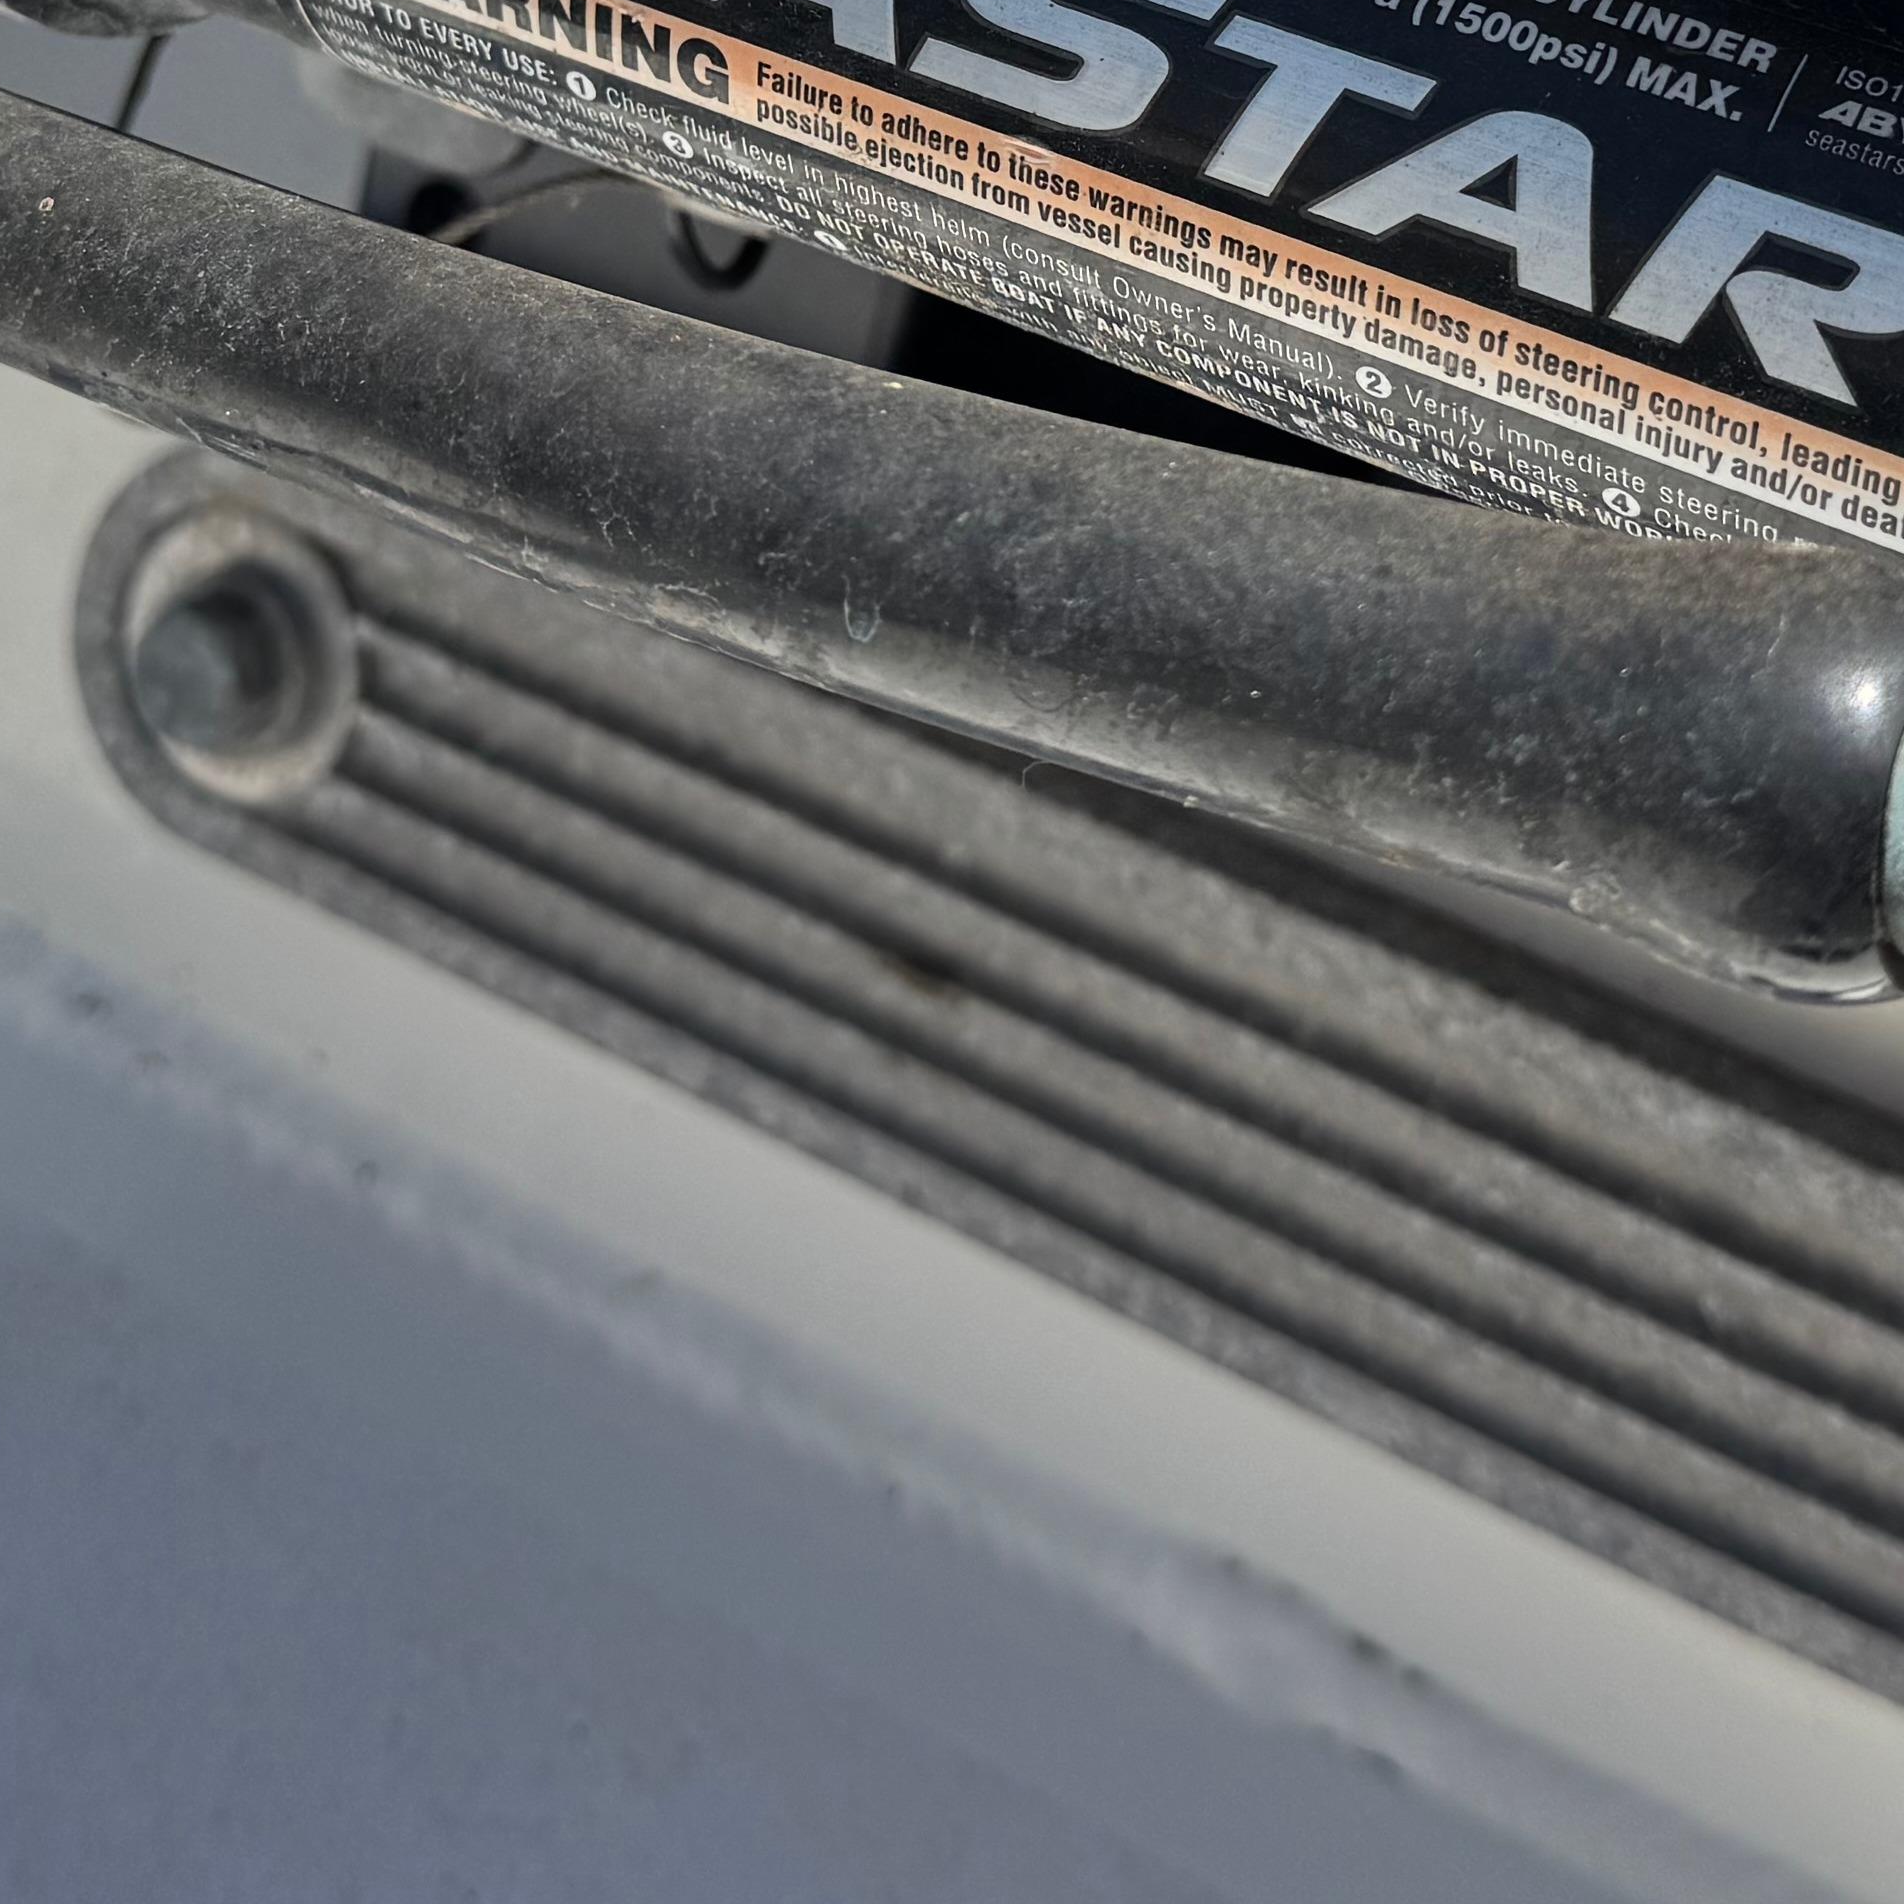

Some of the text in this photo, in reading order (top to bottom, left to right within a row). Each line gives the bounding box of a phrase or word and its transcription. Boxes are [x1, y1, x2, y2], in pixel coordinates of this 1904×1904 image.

[379, 1, 412, 31] TO
[420, 16, 493, 61] EVERY
[502, 48, 558, 86] USE:
[606, 87, 676, 127] Check
[682, 115, 732, 150] fluid
[742, 136, 793, 173] level
[804, 162, 824, 185] in
[835, 173, 921, 222] highest
[932, 204, 989, 247] helm
[1003, 236, 1100, 289] (consult
[1113, 276, 1216, 331] Owner's
[1229, 318, 1342, 380] Manual).
[1405, 384, 1485, 435] Verify
[1498, 420, 1645, 493] immediate
[1659, 485, 1778, 543] steering
[1626, 56, 1743, 122] MAX.
[704, 148, 788, 194] Inspect
[796, 186, 823, 207] all
[833, 199, 928, 250] steering
[937, 236, 1009, 277] hoses
[1019, 269, 1062, 298] and
[1073, 287, 1161, 336] fittings
[1173, 325, 1206, 352] for
[1299, 372, 1395, 427] kinking
[1407, 417, 1496, 460] and/or
[1508, 452, 1588, 497] leaks.
[757, 61, 843, 115] Failure
[850, 96, 874, 127] to
[882, 111, 969, 160] adhere
[978, 141, 1001, 172] to
[1008, 152, 1080, 201] these
[1088, 185, 1212, 249] warnings
[1219, 233, 1278, 279] may
[1284, 257, 1369, 304] result
[1375, 284, 1400, 319] in
[1411, 298, 1471, 344] loss
[1479, 329, 1508, 357] of
[1515, 341, 1640, 410] steering
[1648, 390, 1768, 457] control,
[1781, 432, 1901, 507] leading
[757, 98, 857, 152] possible
[865, 137, 964, 190] ejection
[972, 172, 1030, 216] from
[1037, 200, 1121, 249] vessel
[1129, 234, 1231, 293] causing
[1240, 275, 1356, 339] property
[1364, 316, 1486, 387] damage,
[1497, 368, 1626, 434] personal
[1635, 415, 1723, 474] injury
[1731, 456, 1833, 511] and/or
[777, 195, 811, 220] DO
[817, 212, 863, 241] NOT
[874, 233, 986, 287] OPERATE
[992, 276, 1055, 314] BOAT
[1064, 304, 1086, 325] IF
[1097, 318, 1145, 348] ANY
[1157, 339, 1322, 416] COMPONENT
[1332, 409, 1359, 431] IS
[1367, 421, 1421, 454] NOT
[1431, 445, 1461, 469] IN
[1470, 459, 1586, 517] PROPER
